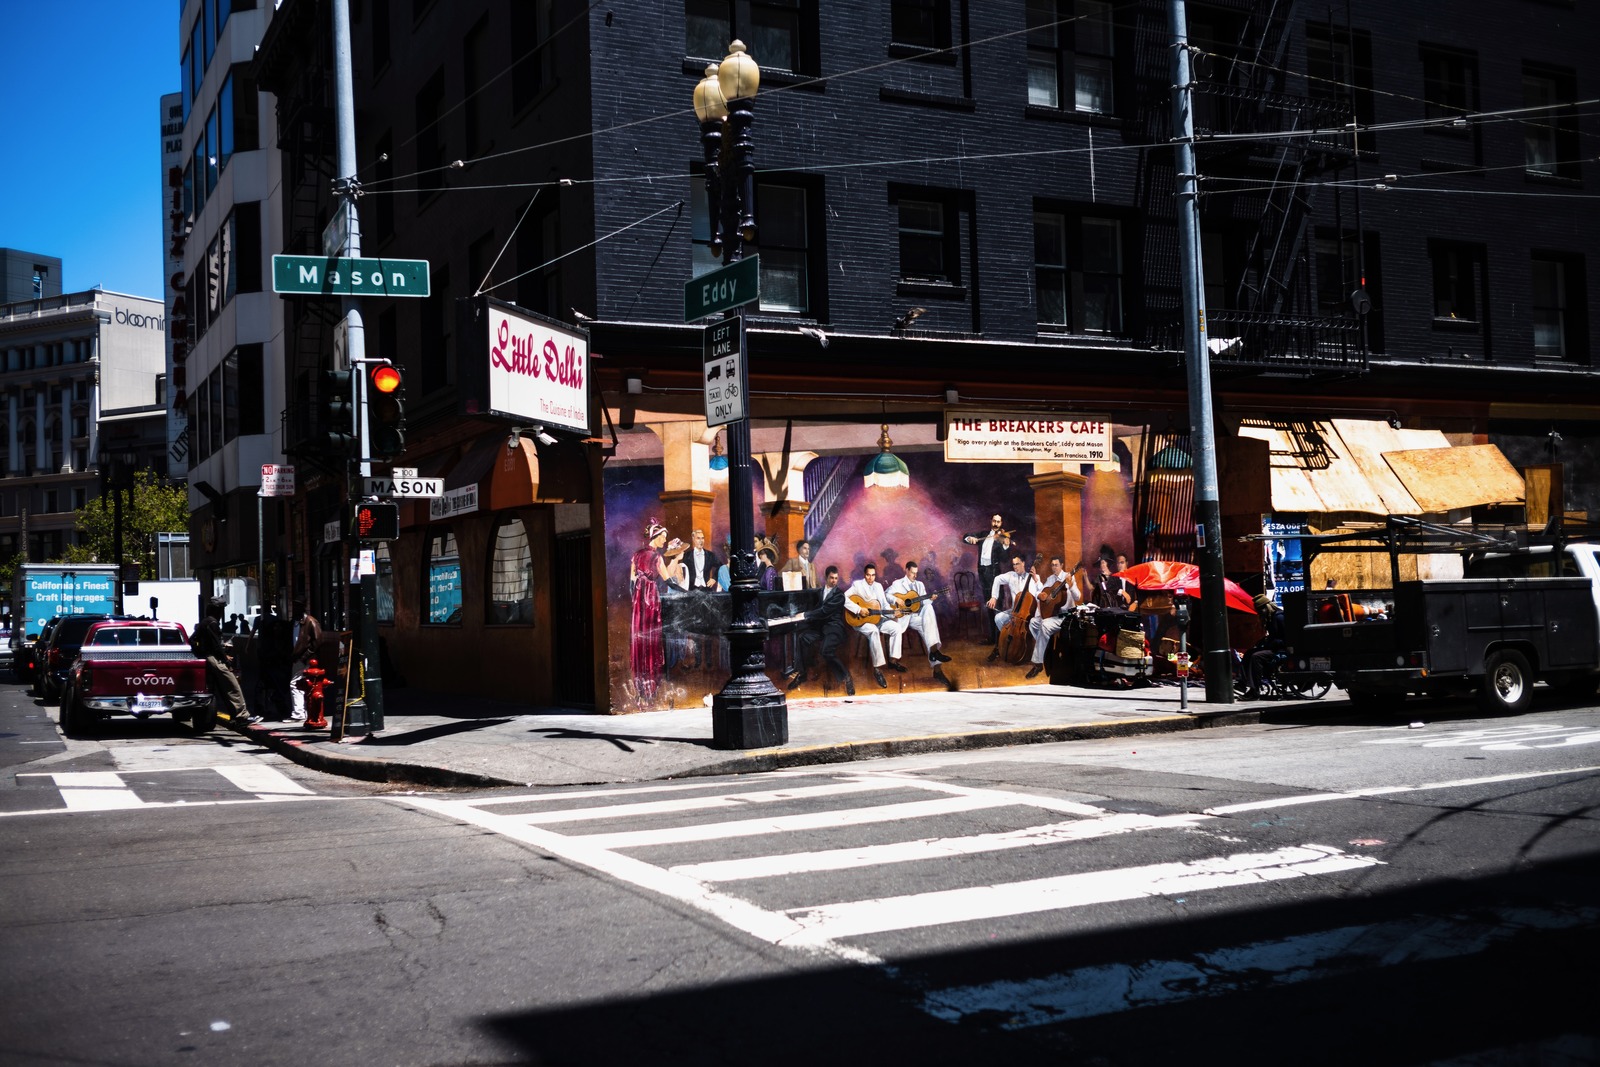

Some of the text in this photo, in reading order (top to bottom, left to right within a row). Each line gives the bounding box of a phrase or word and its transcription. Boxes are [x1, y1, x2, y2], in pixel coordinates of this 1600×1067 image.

[299, 265, 405, 287] Mason
[702, 277, 738, 307] Eddy
[171, 271, 188, 409] CAMERA
[713, 326, 730, 342] LEFT
[491, 319, 583, 390] Little Delhi
[713, 341, 731, 357] LANE
[709, 389, 721, 400] TAXI
[540, 398, 548, 413] The
[550, 400, 567, 417] Cuisine
[715, 402, 733, 417] ONLY
[953, 418, 1104, 434] THE BREAKERS CAFE
[989, 439, 1002, 447] night
[1062, 440, 1074, 448] Eddy
[1089, 450, 1103, 459] 1910
[263, 466, 273, 475] NO
[401, 469, 413, 477] 100
[371, 481, 436, 494] MASON
[31, 581, 109, 590] California's Finest
[36, 593, 105, 603] Craft Beverages
[56, 605, 85, 615] On Tap
[124, 676, 175, 686] TOYOTA
